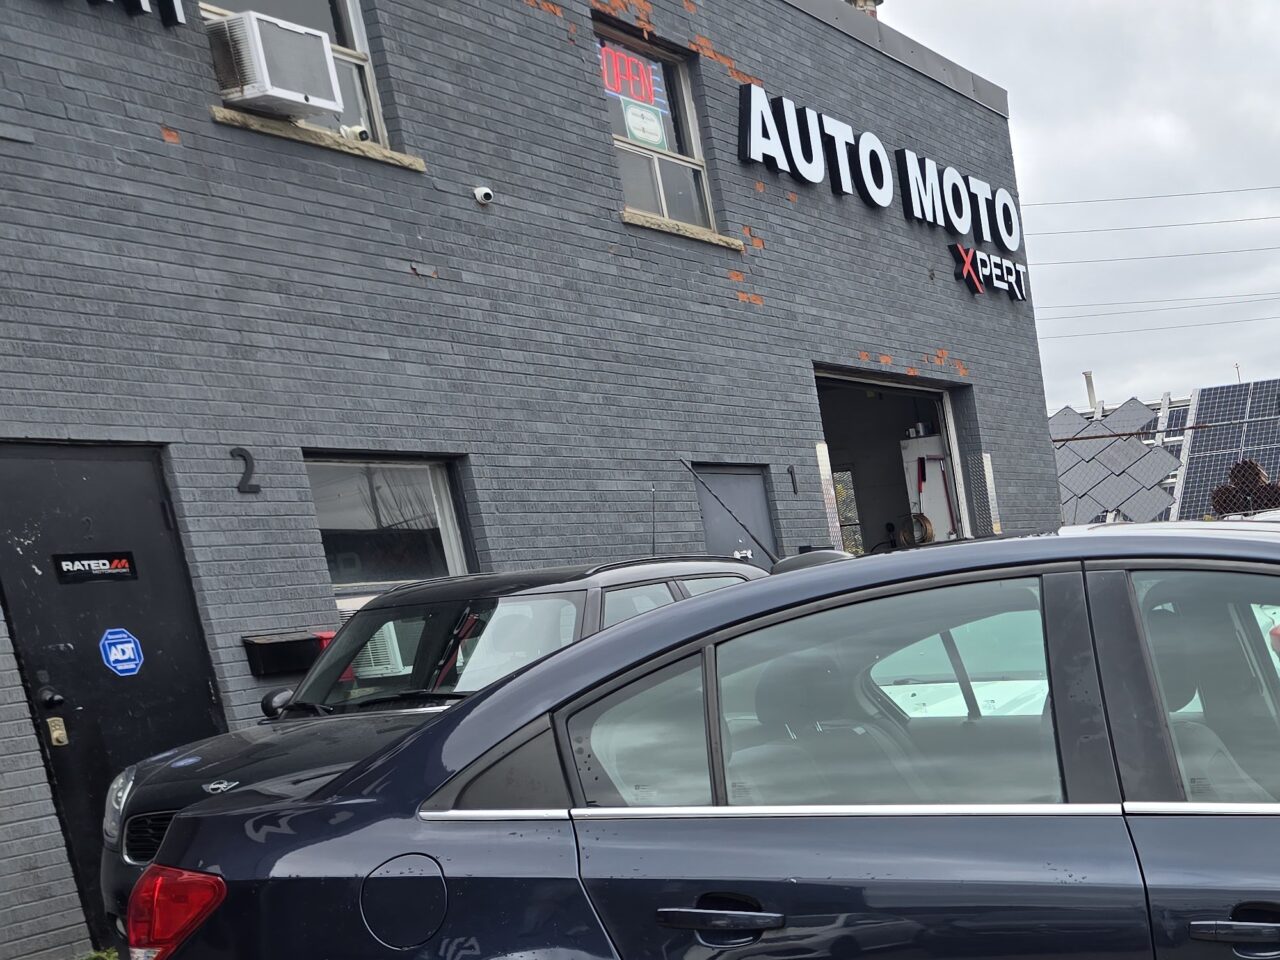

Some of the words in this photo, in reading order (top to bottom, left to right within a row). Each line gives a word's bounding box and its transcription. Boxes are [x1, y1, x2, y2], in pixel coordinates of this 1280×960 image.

[602, 47, 654, 105] OPEN
[749, 83, 893, 208] AUTO
[904, 148, 1020, 252] MOTO
[956, 243, 1027, 300] XPERT
[230, 447, 261, 494] 2
[787, 465, 798, 495] 1
[61, 559, 110, 572] RATED
[110, 643, 135, 661] ADT
